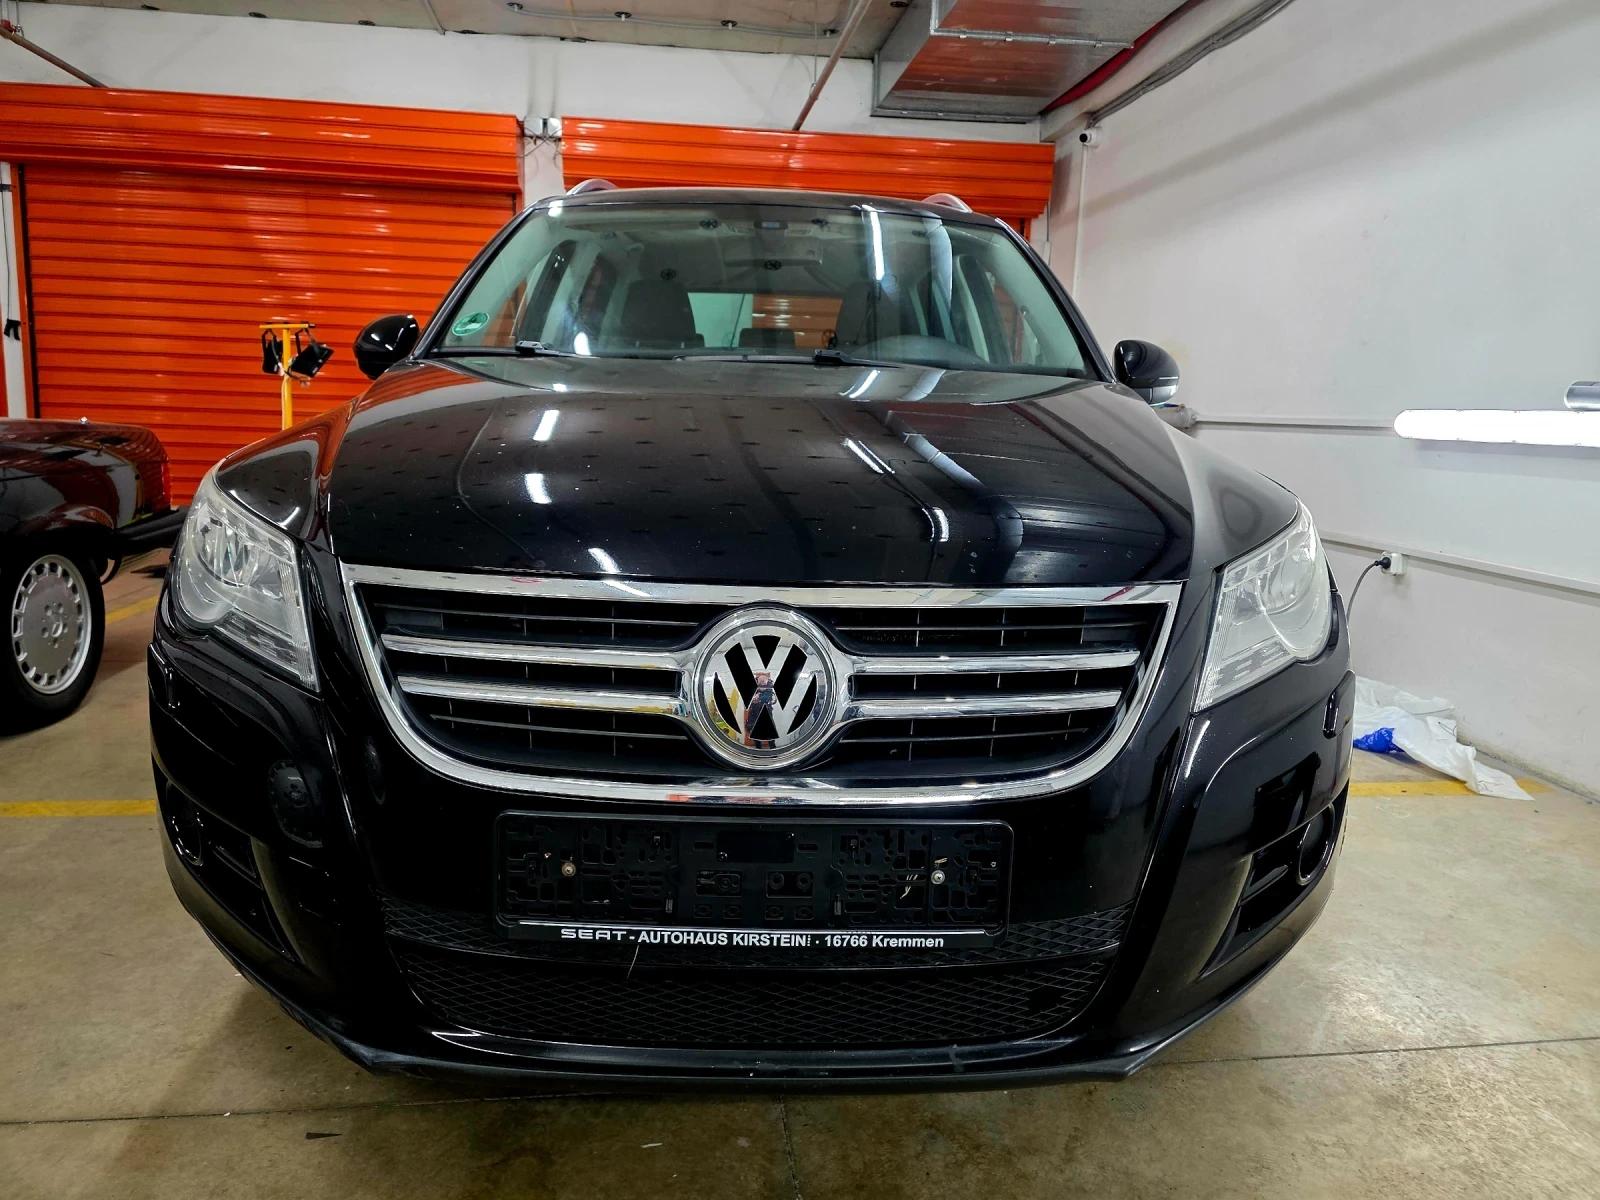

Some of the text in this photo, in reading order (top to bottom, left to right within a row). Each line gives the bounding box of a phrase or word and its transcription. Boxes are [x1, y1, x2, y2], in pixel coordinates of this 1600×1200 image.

[732, 933, 806, 947] KIRSTEIN
[824, 935, 868, 947] 16766
[872, 935, 944, 948] Kremmen
